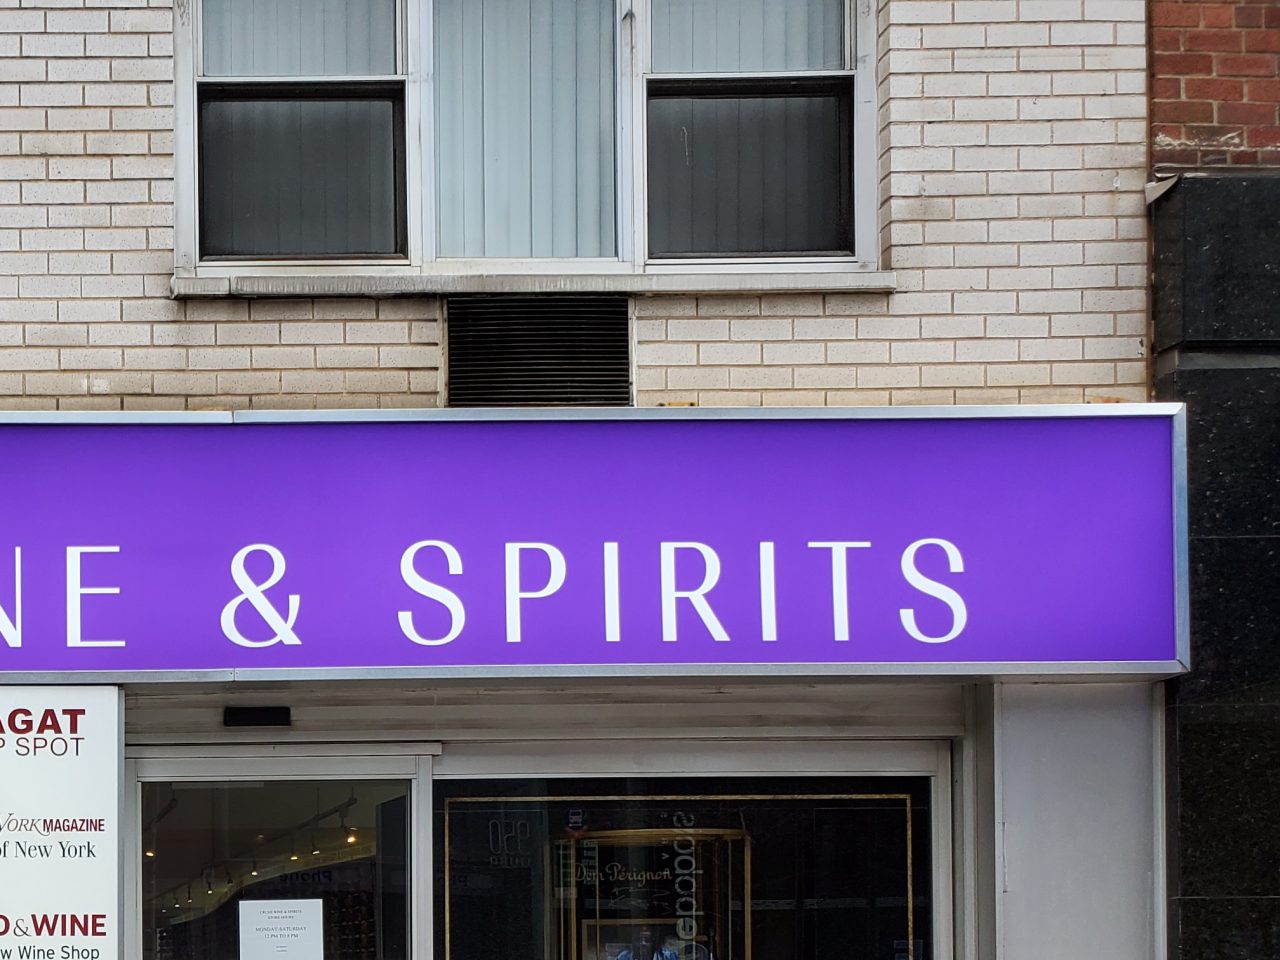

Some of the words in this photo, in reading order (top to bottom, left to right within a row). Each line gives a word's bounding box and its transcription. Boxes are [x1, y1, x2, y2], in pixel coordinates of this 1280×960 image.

[219, 542, 303, 648] &
[397, 537, 968, 646] SPIRITS
[15, 737, 85, 756] SPOT
[43, 819, 105, 832] MAGAZINE
[14, 841, 52, 858] New
[58, 841, 96, 858] York
[17, 945, 55, 960] Wine
